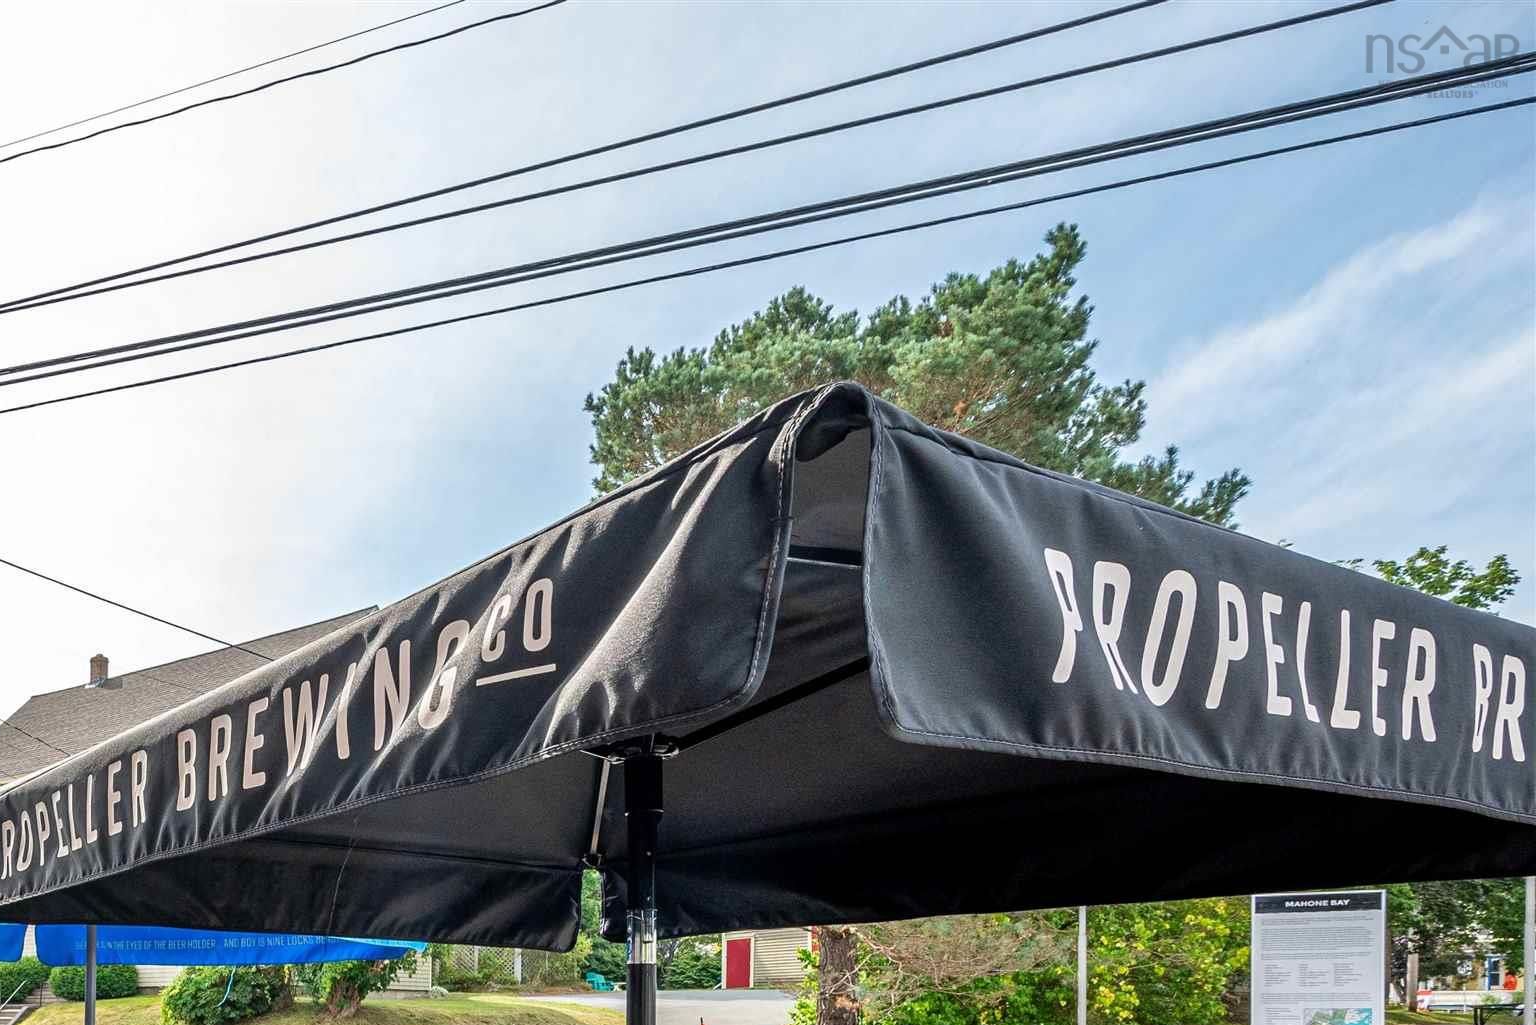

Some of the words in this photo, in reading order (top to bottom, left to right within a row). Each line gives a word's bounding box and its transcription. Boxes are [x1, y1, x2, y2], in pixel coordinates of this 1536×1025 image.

[1044, 547, 1437, 743] PROPELLER
[1472, 642, 1526, 763] BR
[176, 619, 471, 812] BREWING
[153, 939, 168, 950] THE
[168, 938, 186, 949] BEER
[187, 937, 216, 949] HOLDER
[223, 938, 240, 948] AND
[240, 937, 256, 948] BOY
[266, 936, 285, 947] NINE
[287, 935, 314, 945] LOCKS
[1284, 899, 1329, 908] MAHONE
[1330, 898, 1350, 907] BAY
